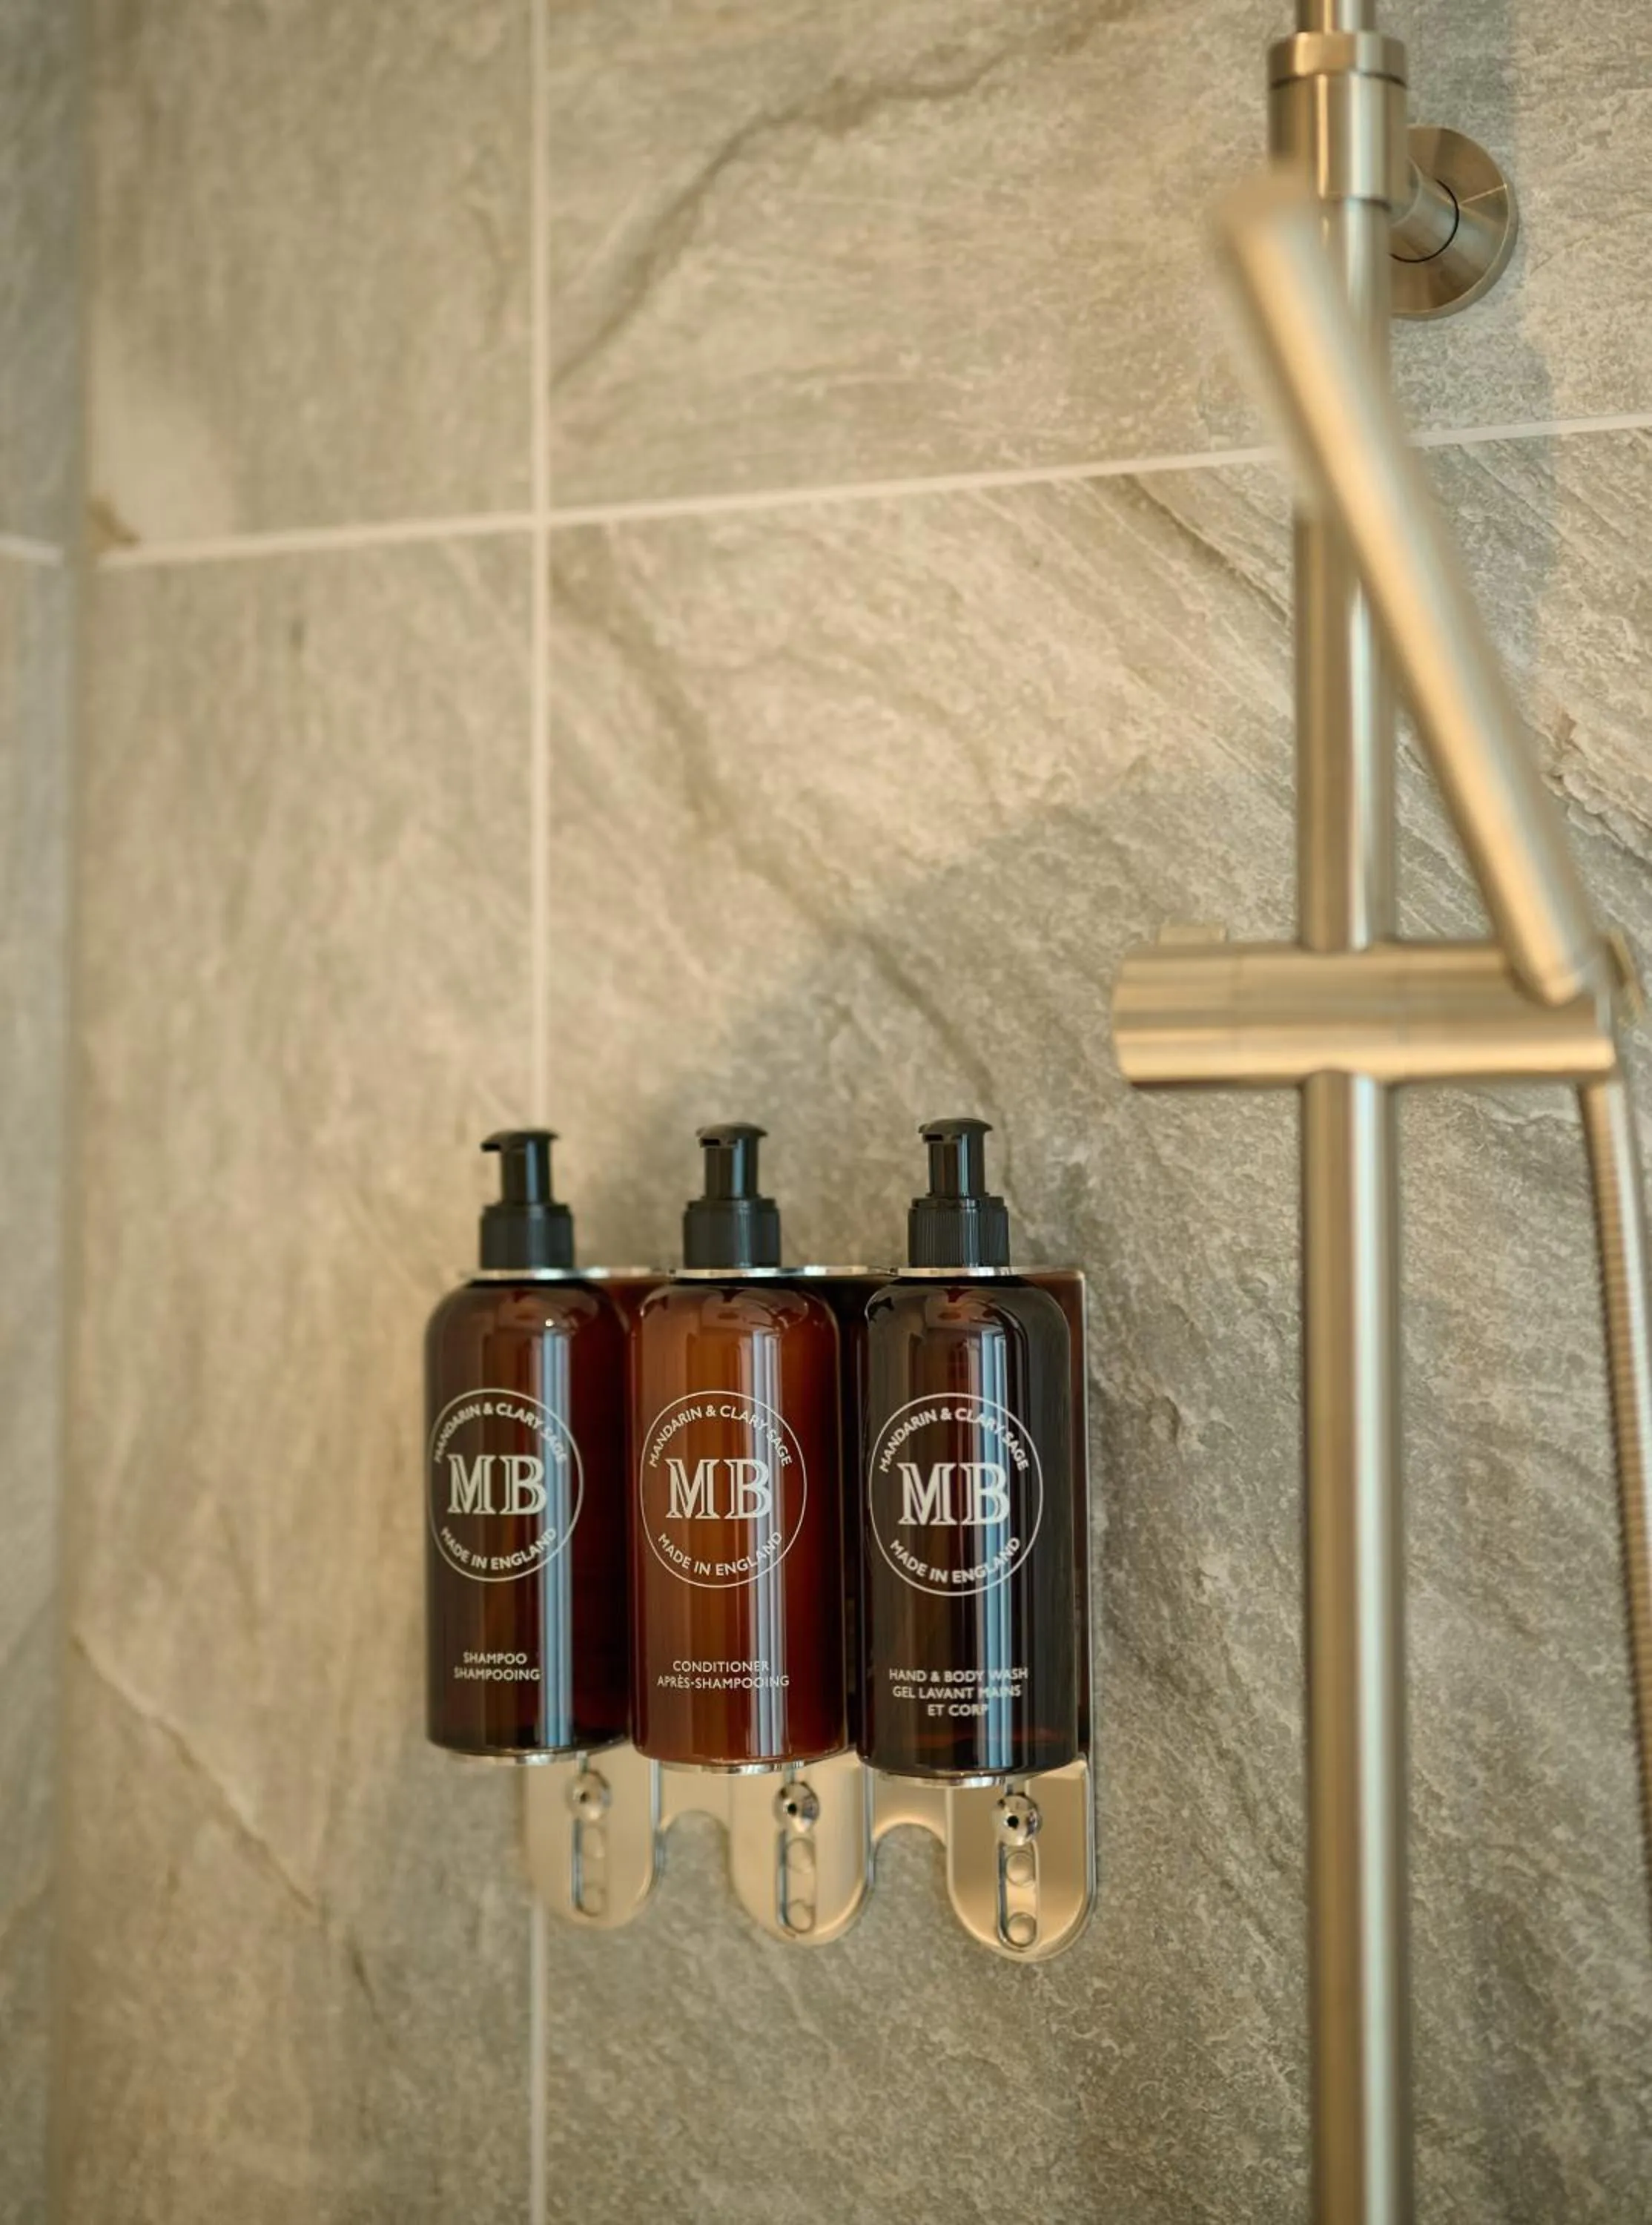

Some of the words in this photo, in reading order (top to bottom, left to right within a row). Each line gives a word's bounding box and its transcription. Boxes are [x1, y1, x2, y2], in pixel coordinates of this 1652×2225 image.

[435, 1404, 480, 1464] MANDARIN
[483, 1402, 494, 1416] &
[496, 1402, 543, 1430] CLARY
[540, 1426, 568, 1465] SAGE
[650, 1405, 702, 1468] MANDARIN
[705, 1404, 716, 1417] &
[720, 1405, 768, 1431] CLARY
[766, 1428, 792, 1467] SAGE
[879, 1408, 938, 1473] MANDARIN
[940, 1407, 953, 1421] &
[955, 1407, 1006, 1435] CLARY
[1002, 1431, 1029, 1472] SAGE
[447, 1454, 548, 1515] MB
[665, 1458, 773, 1520] MB
[896, 1462, 1011, 1526] MB
[440, 1526, 469, 1563] MADE
[471, 1555, 487, 1570] IN
[491, 1528, 556, 1571] ENGLAND
[658, 1533, 690, 1569] MADE
[693, 1560, 711, 1576] IN
[716, 1532, 782, 1576] ENGLAND
[890, 1539, 927, 1577] MADE
[929, 1567, 948, 1584] IN
[951, 1537, 1020, 1584] ENGLAND
[453, 1667, 541, 1681] SHAMPOOING
[463, 1651, 528, 1665] SHAMPOO
[673, 1660, 770, 1673] CONDITIONER
[888, 1668, 927, 1681] HAND
[930, 1671, 941, 1683] &
[944, 1670, 985, 1683] BODY
[988, 1667, 1028, 1681] WASH
[892, 1685, 916, 1698] GEL
[919, 1687, 975, 1699] LAVANT
[977, 1684, 1022, 1698] MAINS
[928, 1703, 945, 1717] ET
